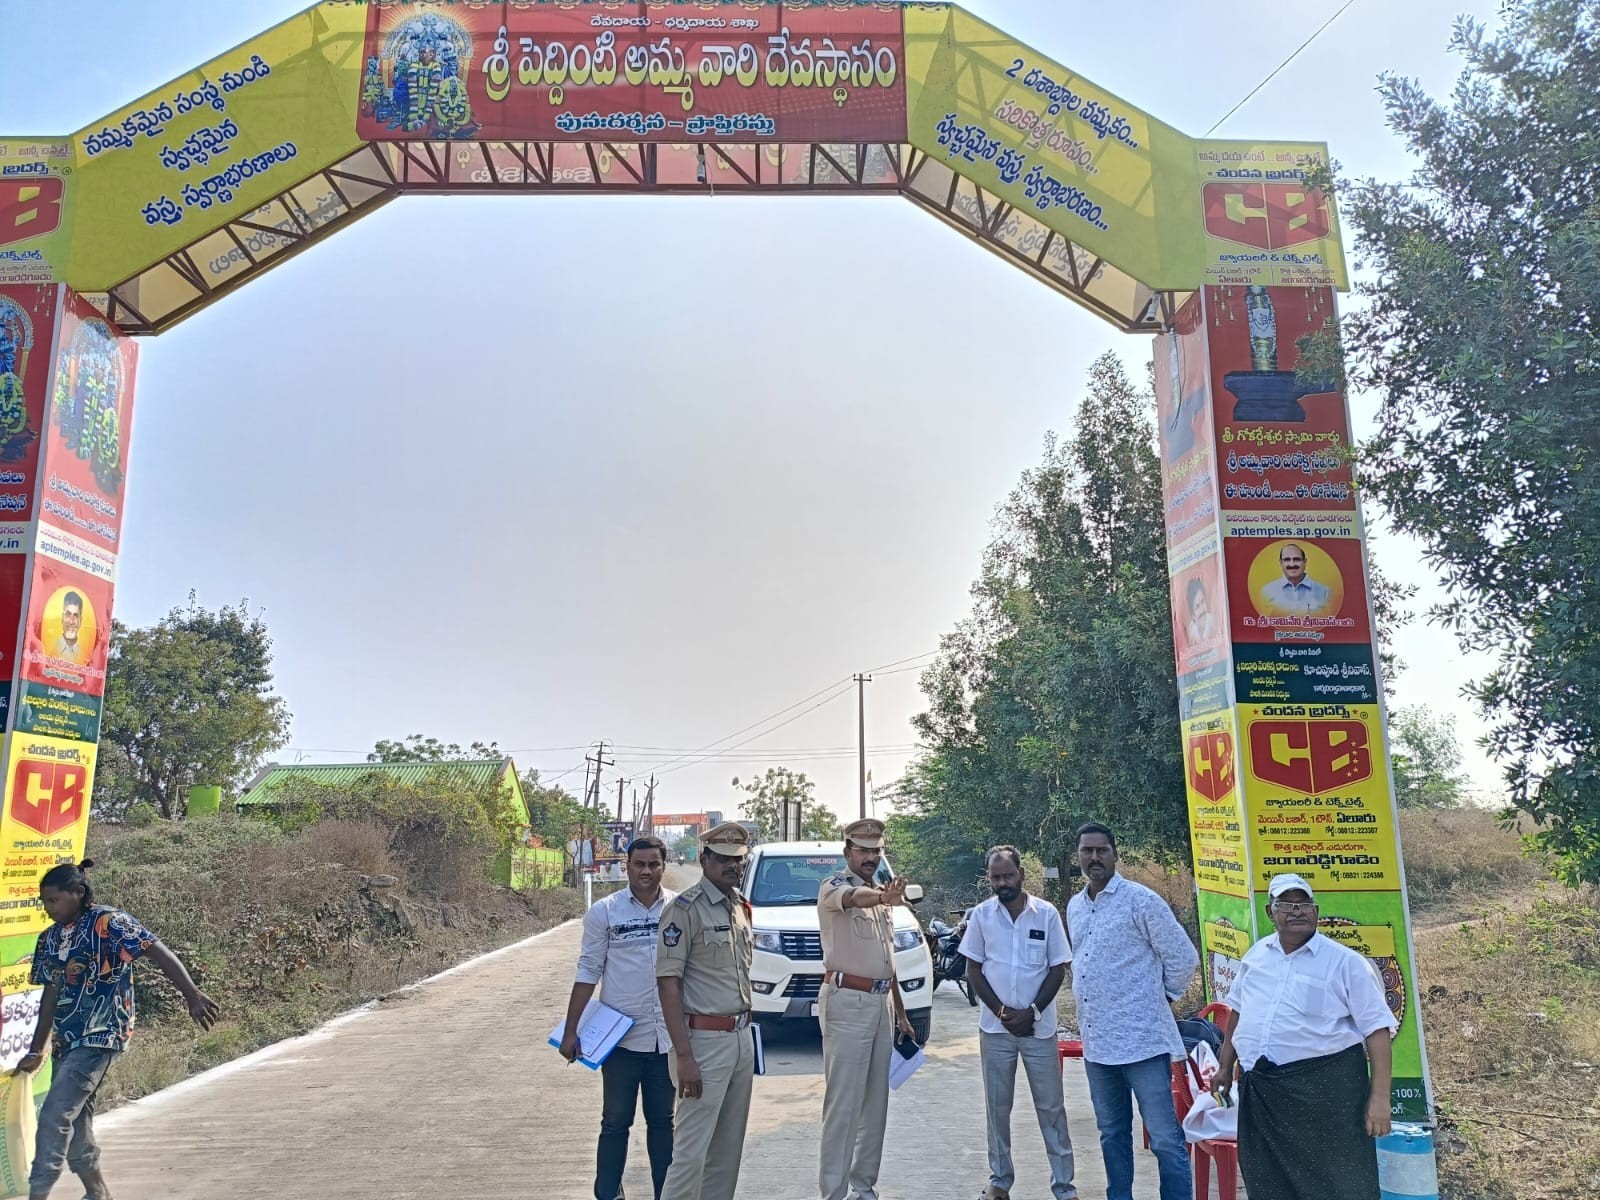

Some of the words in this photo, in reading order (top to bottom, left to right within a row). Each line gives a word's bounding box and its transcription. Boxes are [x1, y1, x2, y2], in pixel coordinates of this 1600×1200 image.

[590, 15, 651, 27] దేవదాయ
[665, 16, 725, 30] ధర్మదాయ
[729, 18, 759, 28] శాఖ
[481, 25, 511, 101] శ్రీ
[518, 30, 617, 105] పెద్దింటి
[624, 37, 694, 111] అమ్మ
[698, 43, 758, 88] వారి
[765, 27, 896, 108] దేవస్థానం
[1004, 58, 1024, 80] 2
[1023, 68, 1082, 116] దశాబ్దాల
[83, 102, 173, 156] నమ్మకమైన
[173, 80, 225, 112] సంస్థ
[219, 55, 271, 93] నుండి
[555, 111, 666, 135] పునఃదర్శన
[685, 114, 775, 135] ప్రాప్తిరస్తు
[994, 99, 1049, 151] సరికొత్త
[158, 118, 239, 172] స్వచ్ఛమైన
[936, 113, 1001, 163] స్వచ్ఛమైన
[181, 140, 297, 209] స్వర్ణాభరణాలు
[1231, 526, 1350, 538] aptemples.ap.gov.in
[40, 540, 112, 577] aptemples.ap.gov.in
[1262, 705, 1306, 716] చందన
[1309, 704, 1350, 719] బ్రదర్స్
[1247, 719, 1373, 797] CB
[1314, 798, 1322, 806] &
